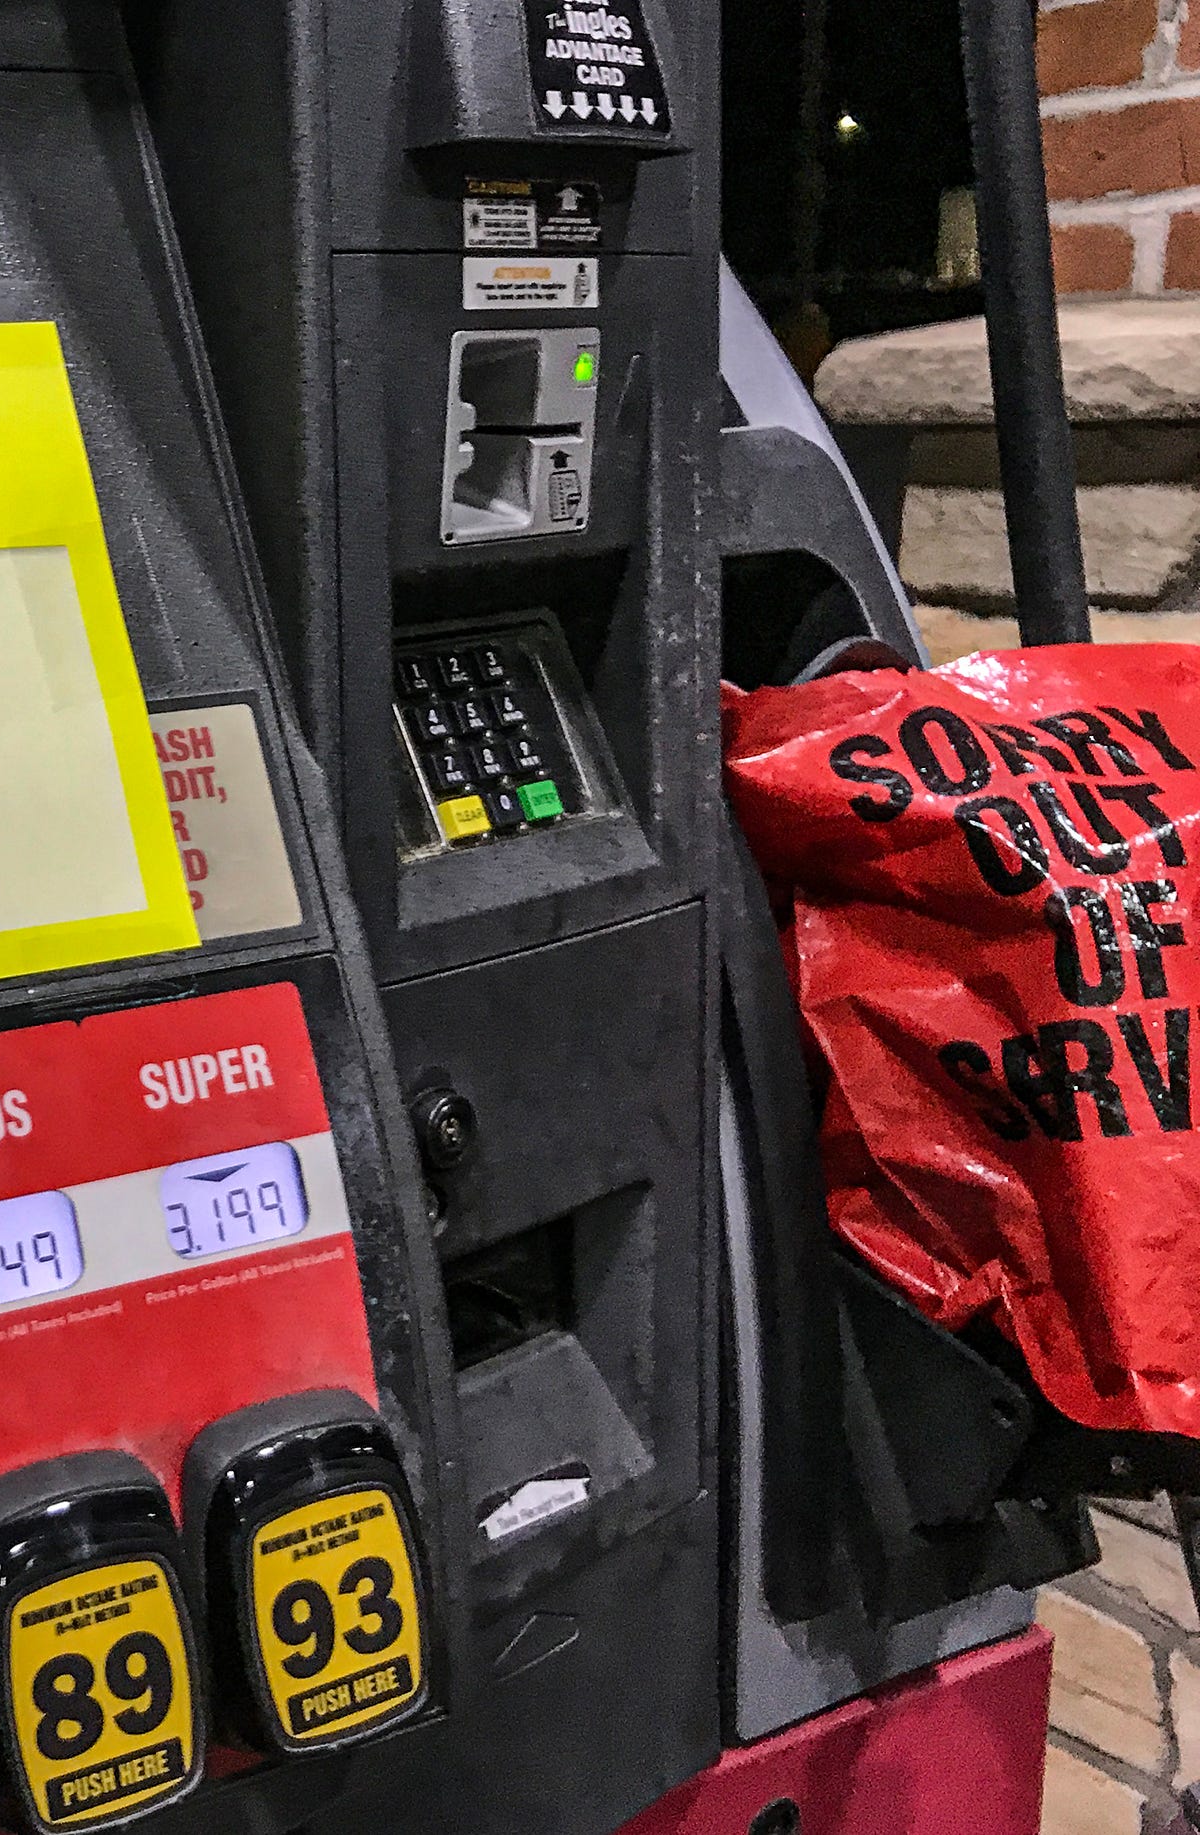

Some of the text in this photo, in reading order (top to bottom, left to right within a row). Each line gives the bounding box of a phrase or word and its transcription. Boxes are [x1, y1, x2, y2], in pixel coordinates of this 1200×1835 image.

[545, 39, 645, 67] ADVANTAGE
[576, 64, 626, 87] CARD
[449, 657, 460, 672] 2
[486, 651, 497, 666] 3
[466, 702, 477, 718] 5
[153, 726, 215, 763] ASH
[483, 748, 494, 764] 8
[830, 706, 1196, 822] SORRY
[163, 765, 228, 803] DIT,
[955, 781, 1187, 896] OUT
[1046, 879, 1186, 1006] OF
[139, 1043, 275, 1110] SUPER
[166, 1181, 287, 1256] 3.199
[272, 1556, 404, 1679] 93
[32, 1631, 173, 1761] 89
[301, 1666, 401, 1722] PUSH HERE
[61, 1750, 170, 1808] PUSH HERE
